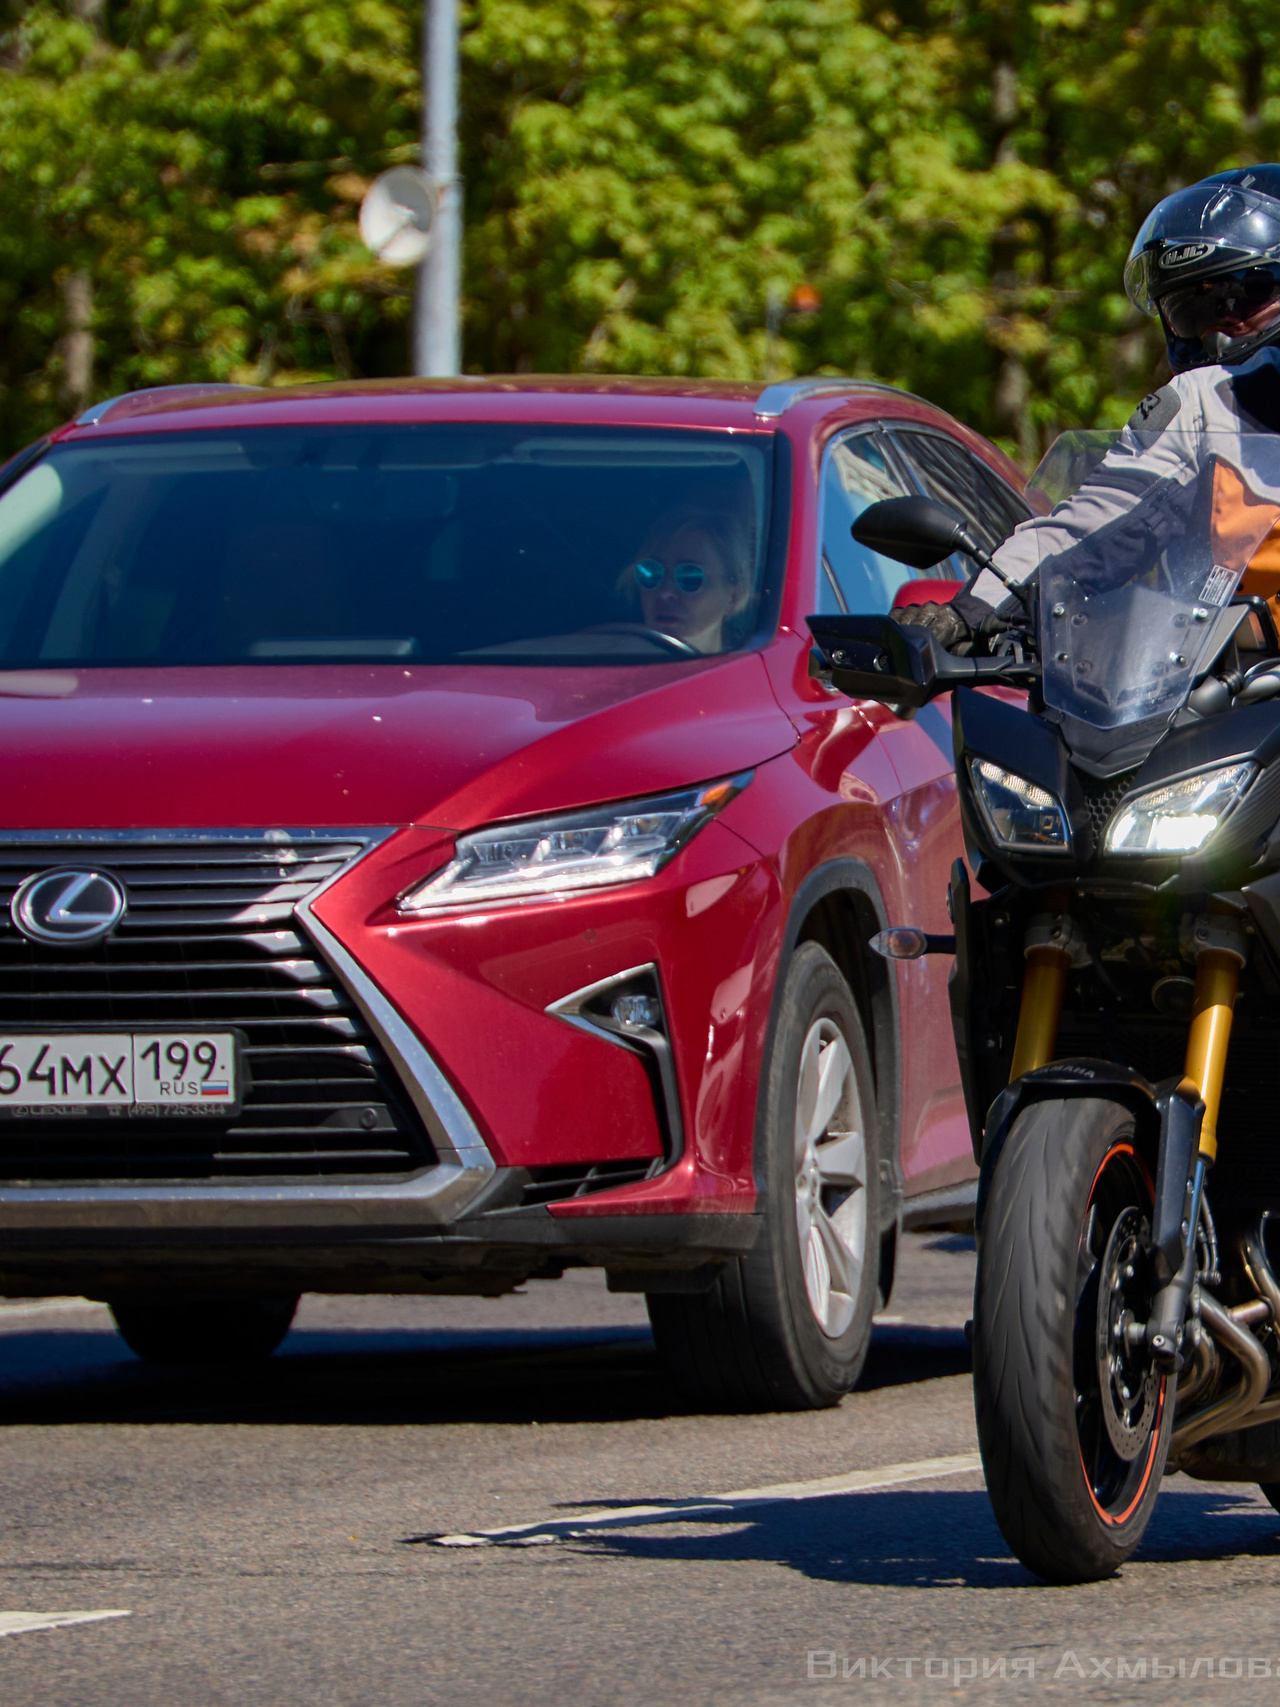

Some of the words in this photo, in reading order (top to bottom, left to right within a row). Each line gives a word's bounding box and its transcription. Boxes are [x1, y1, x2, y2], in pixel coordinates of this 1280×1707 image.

[140, 1039, 217, 1080] 199
[159, 1081, 199, 1096] RUS
[30, 1105, 88, 1115] LEXUS
